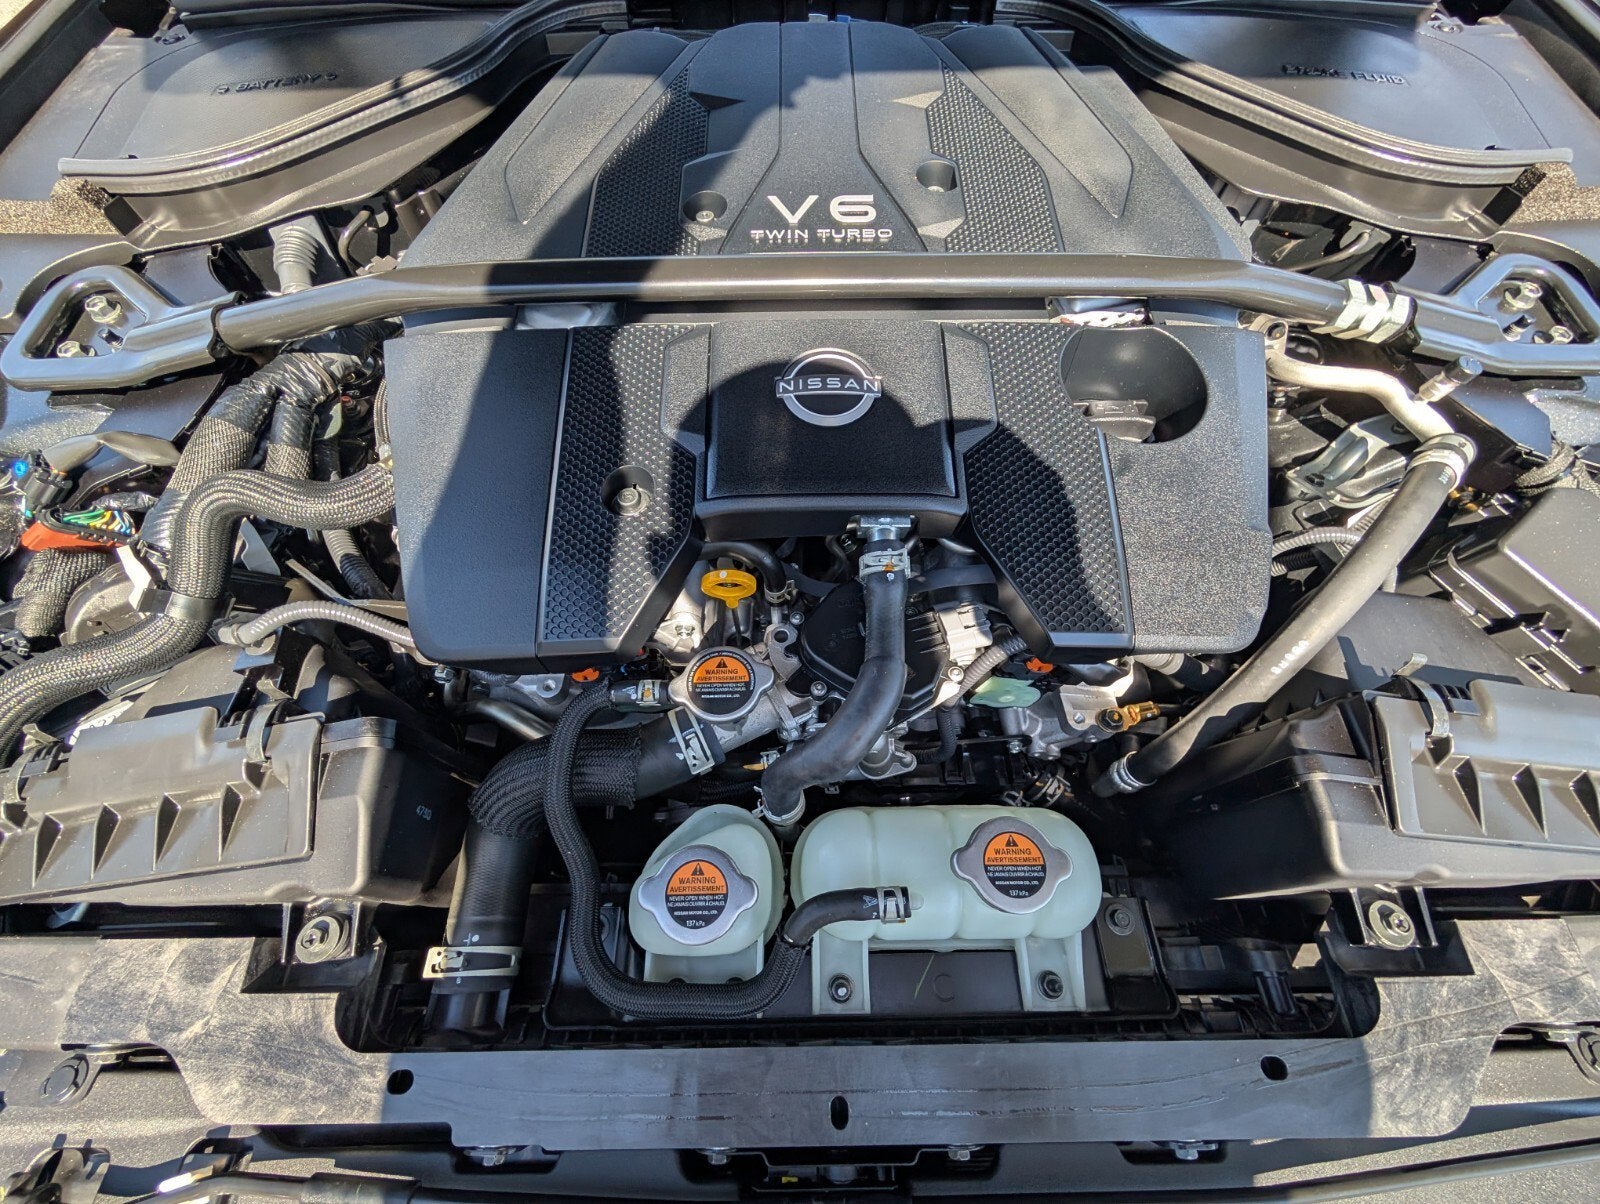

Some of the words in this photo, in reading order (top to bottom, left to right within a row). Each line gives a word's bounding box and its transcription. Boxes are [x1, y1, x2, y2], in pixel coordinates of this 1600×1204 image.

[1351, 71, 1404, 84] FLUID
[750, 229, 808, 243] TWIN
[817, 228, 892, 243] TURBO
[780, 377, 878, 392] NISSAN
